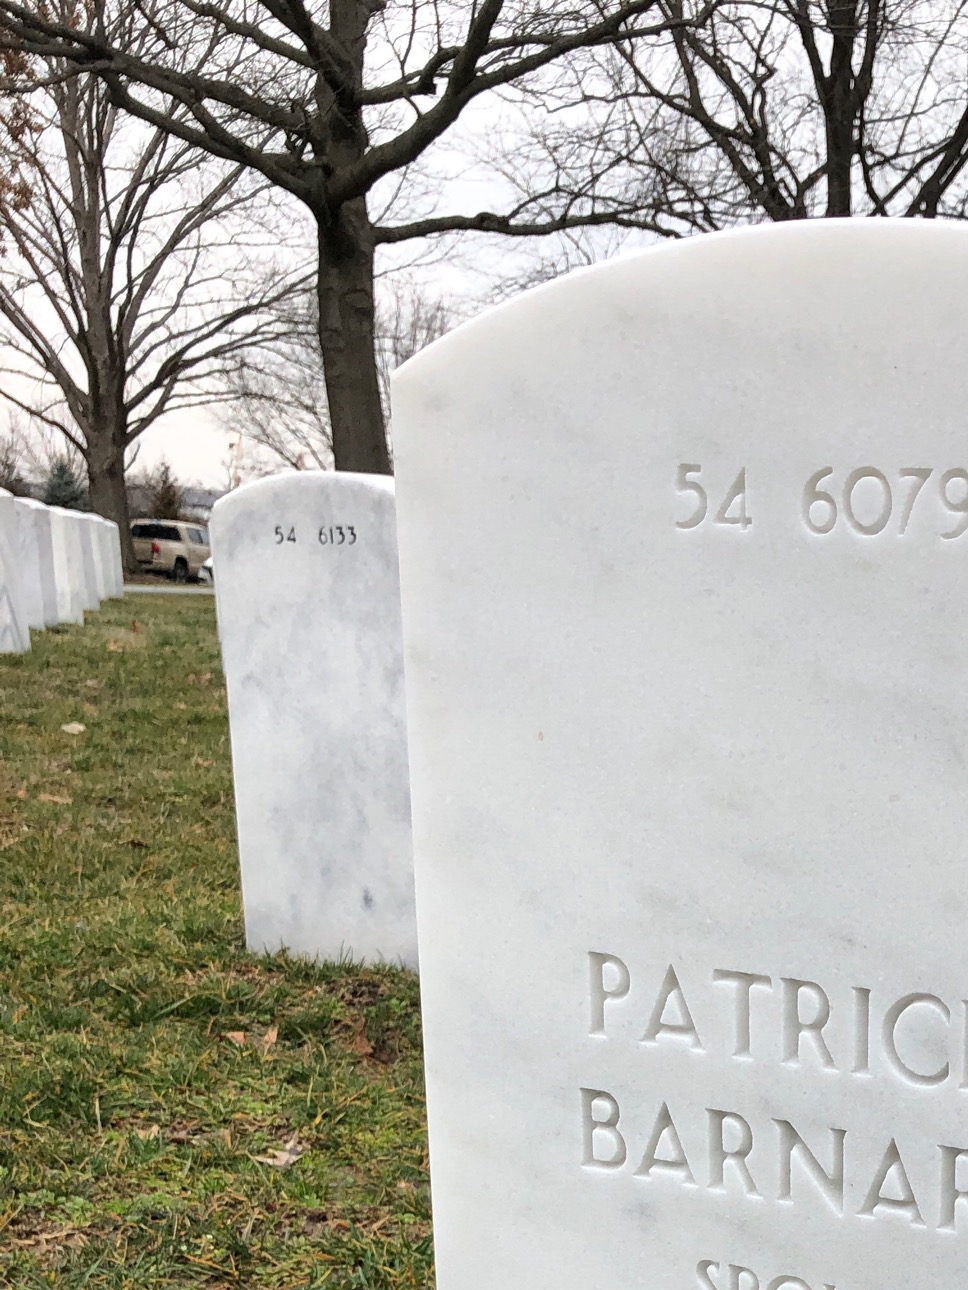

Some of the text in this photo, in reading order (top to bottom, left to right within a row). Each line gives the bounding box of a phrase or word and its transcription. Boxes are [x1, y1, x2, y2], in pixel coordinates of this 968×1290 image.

[675, 462, 752, 532] 54
[274, 524, 357, 546] 54 6133
